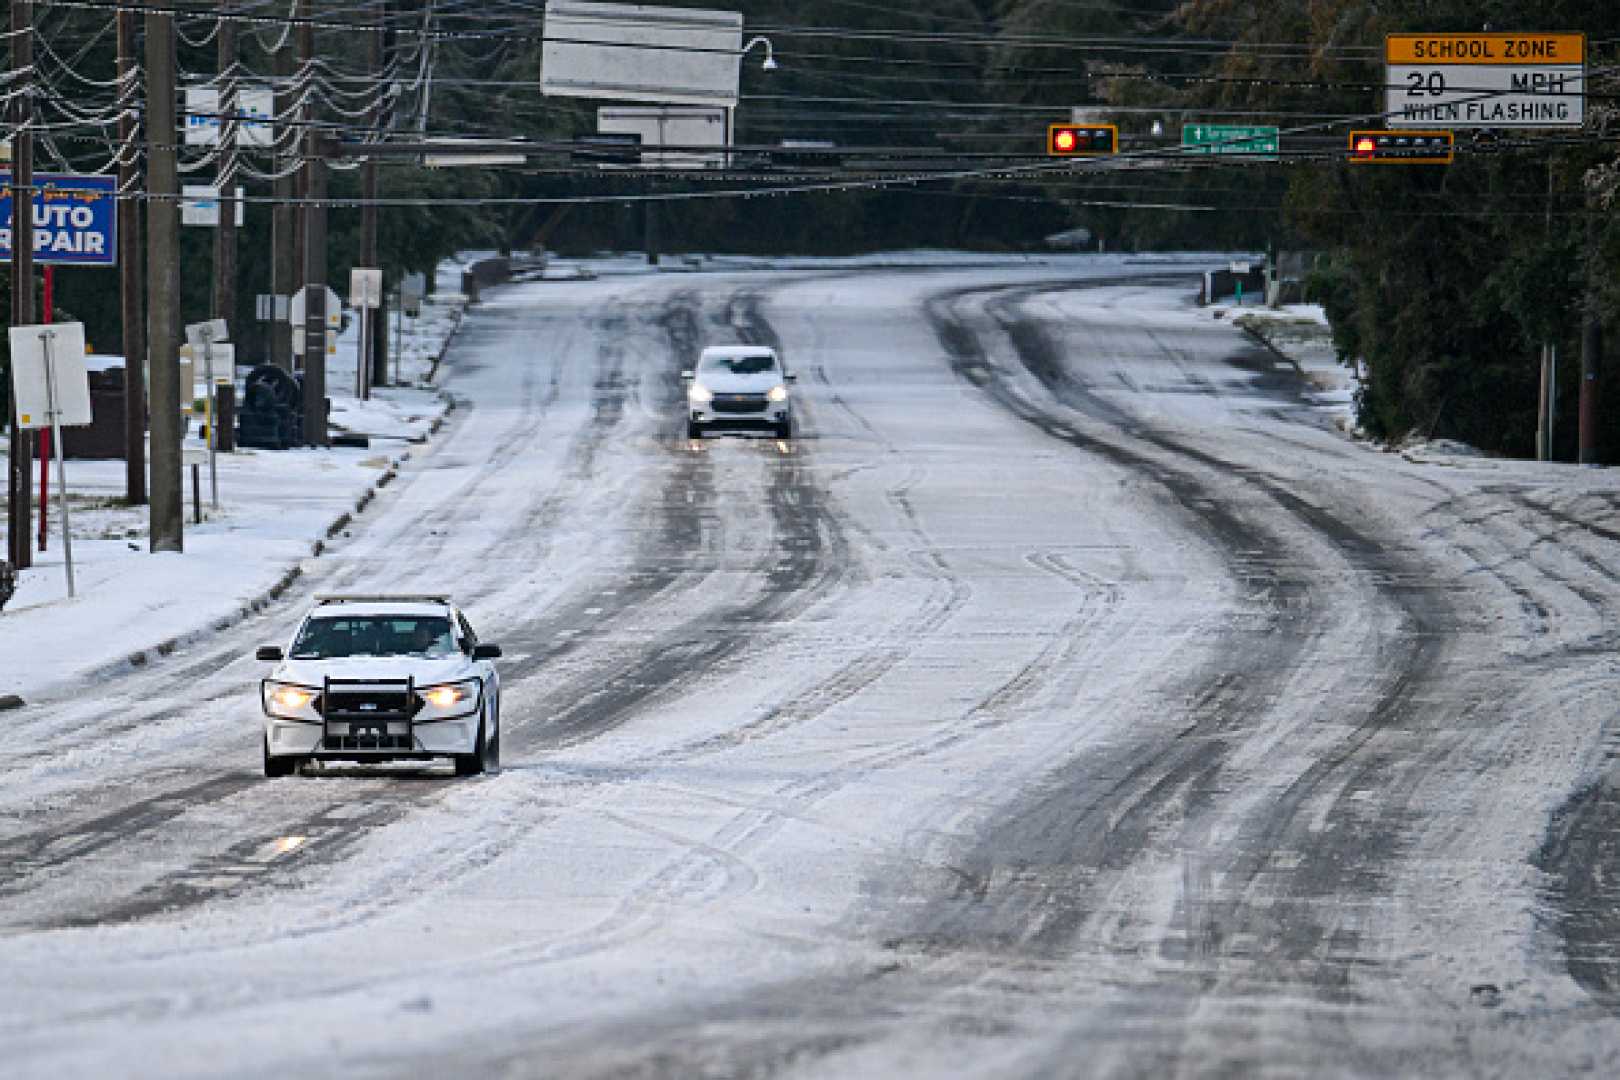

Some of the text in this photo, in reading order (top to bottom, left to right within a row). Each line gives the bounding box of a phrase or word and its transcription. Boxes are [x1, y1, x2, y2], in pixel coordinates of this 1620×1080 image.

[1414, 40, 1558, 58] SCHOOL ZONE
[1406, 71, 1563, 96] 20 MPH
[1404, 103, 1568, 121] WHEN FLASHING
[8, 204, 93, 227] UTO
[0, 229, 104, 253] RPAIR
